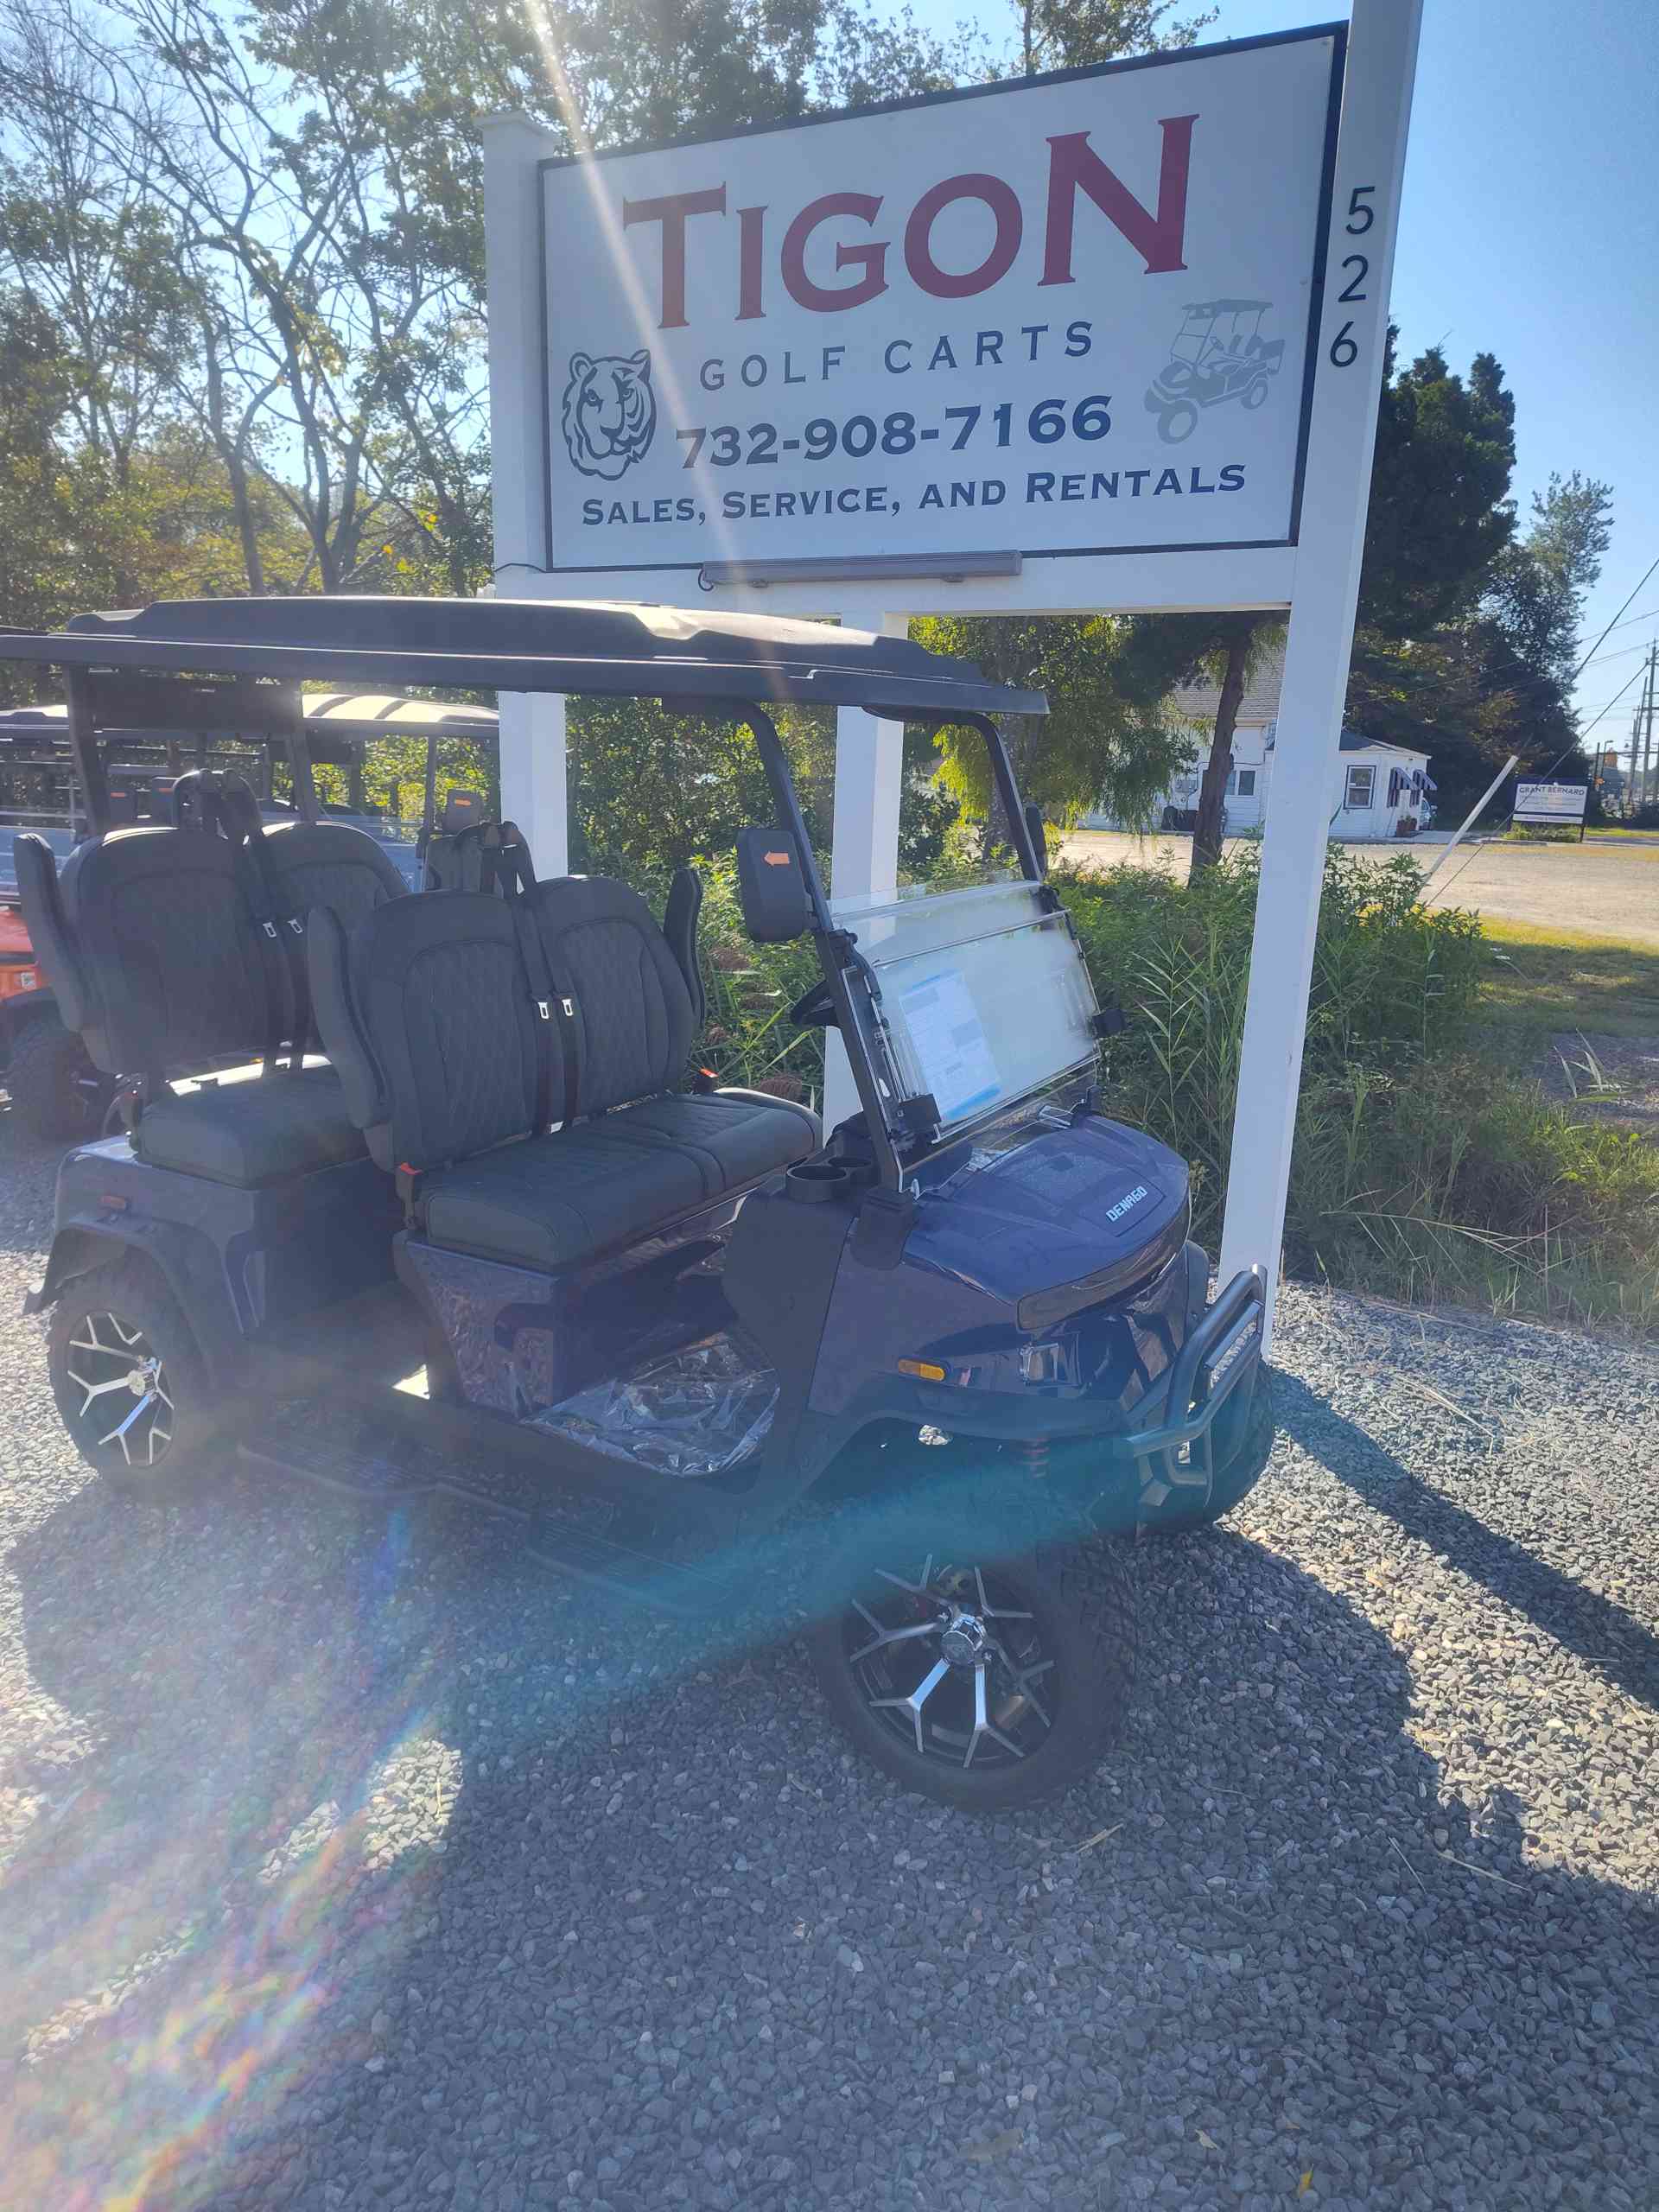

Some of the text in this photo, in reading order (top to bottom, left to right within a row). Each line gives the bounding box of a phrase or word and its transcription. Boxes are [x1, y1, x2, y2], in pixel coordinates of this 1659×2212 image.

[622, 112, 1199, 329] TIGON
[699, 320, 1094, 392] GOLF CARTS
[675, 394, 1113, 469] 732-908-7166
[581, 463, 1246, 526] SALES, SERVICE, AND RENTALS
